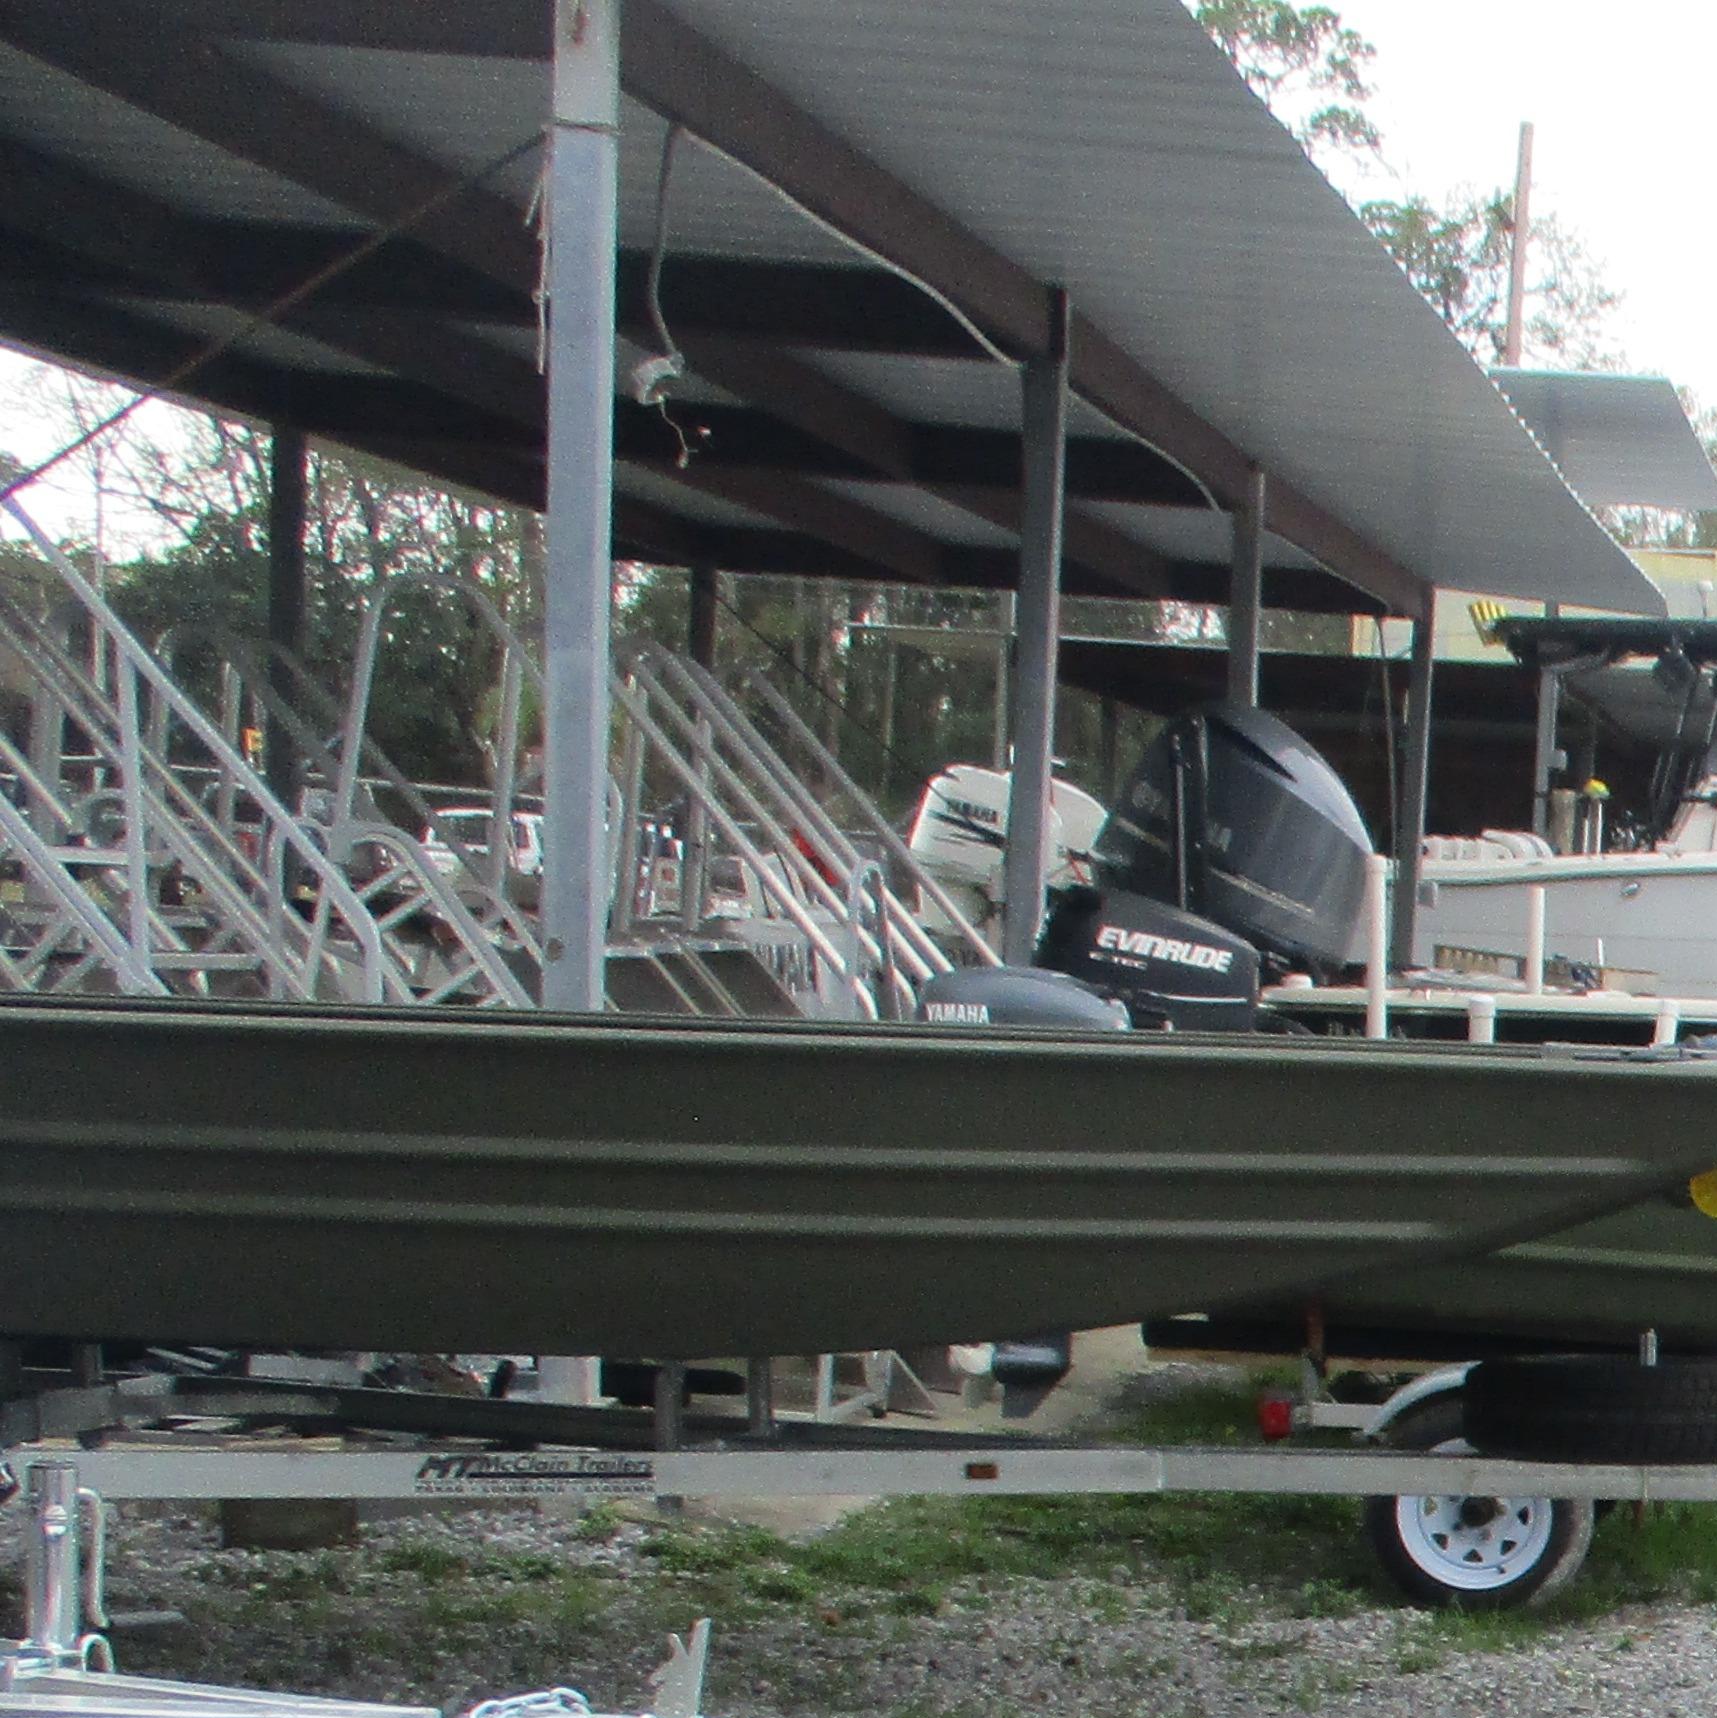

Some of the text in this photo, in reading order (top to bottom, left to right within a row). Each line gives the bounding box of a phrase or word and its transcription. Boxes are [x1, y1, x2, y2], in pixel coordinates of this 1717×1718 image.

[1097, 926, 1232, 974] EVINRUDE
[925, 1003, 990, 1025] YAMAHA
[481, 1455, 569, 1473] McClain
[577, 1455, 654, 1473] Trailers
